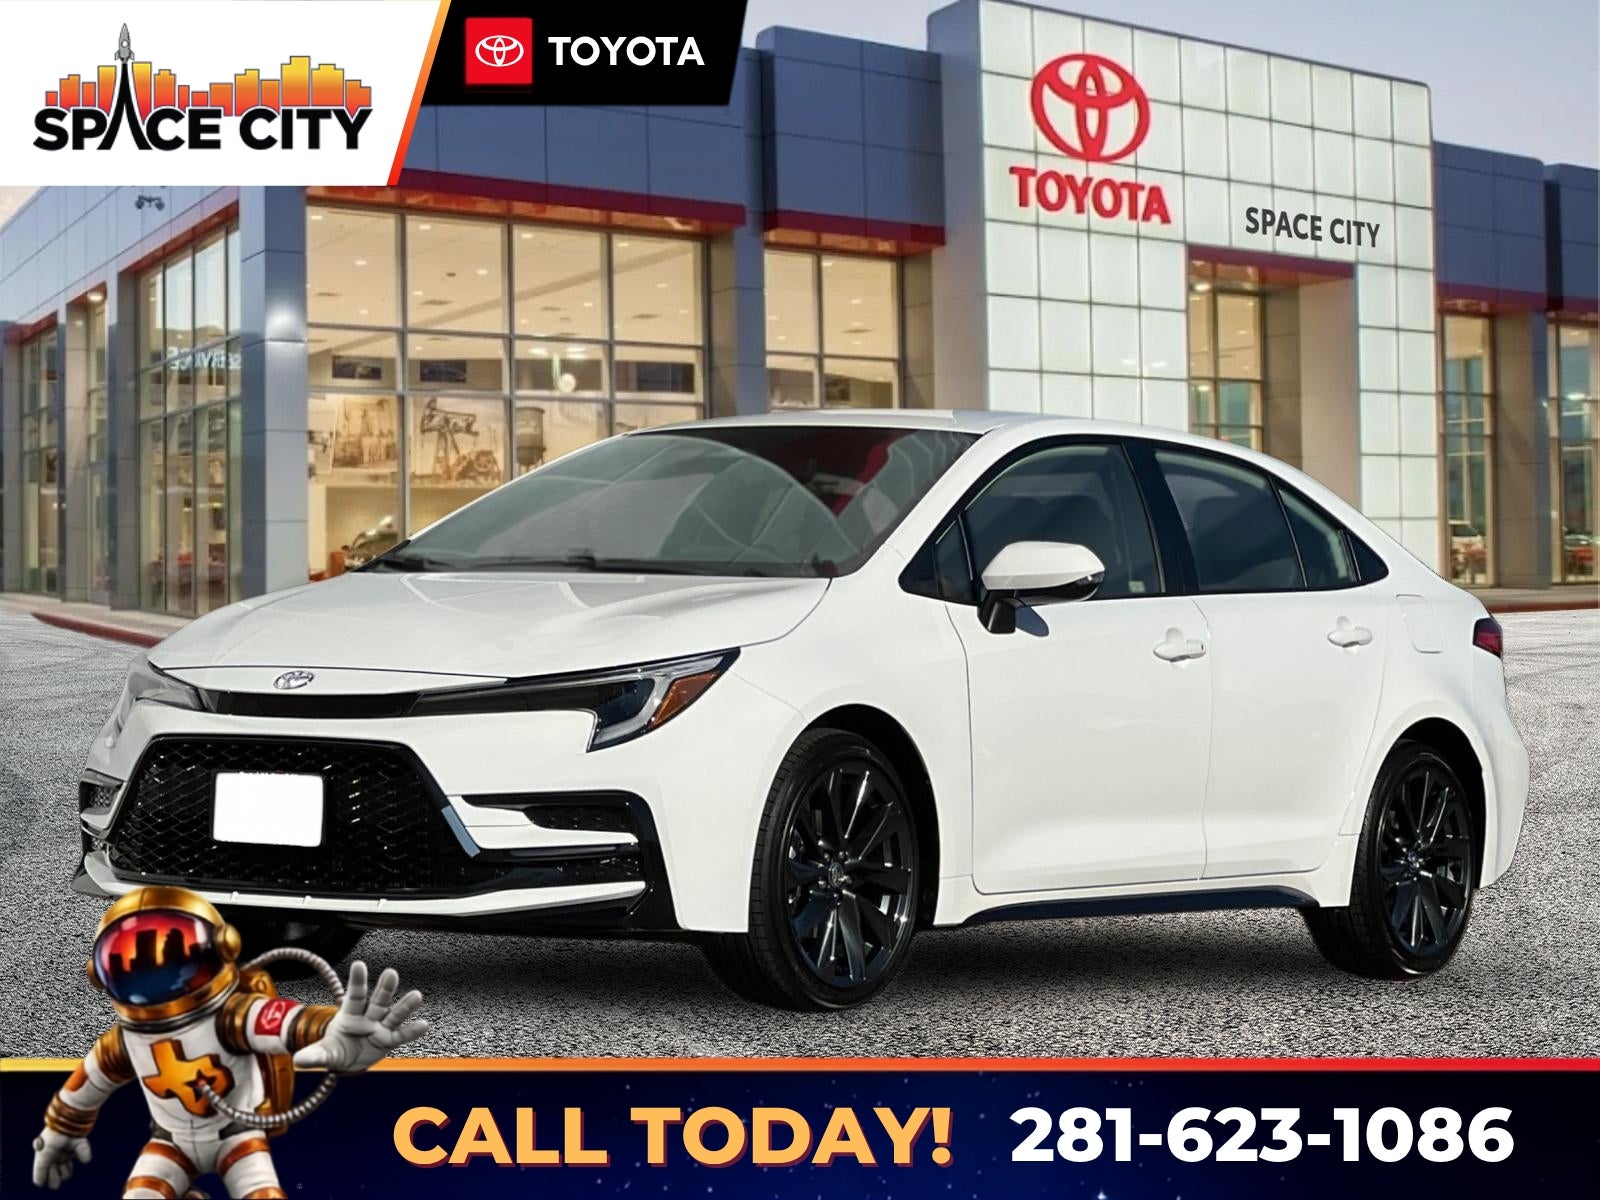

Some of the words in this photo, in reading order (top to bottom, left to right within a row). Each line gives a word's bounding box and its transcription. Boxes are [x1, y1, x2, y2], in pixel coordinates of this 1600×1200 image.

[1009, 166, 1172, 225] TOYOTA
[1245, 206, 1322, 242] SPACE
[1329, 218, 1381, 248] CITY
